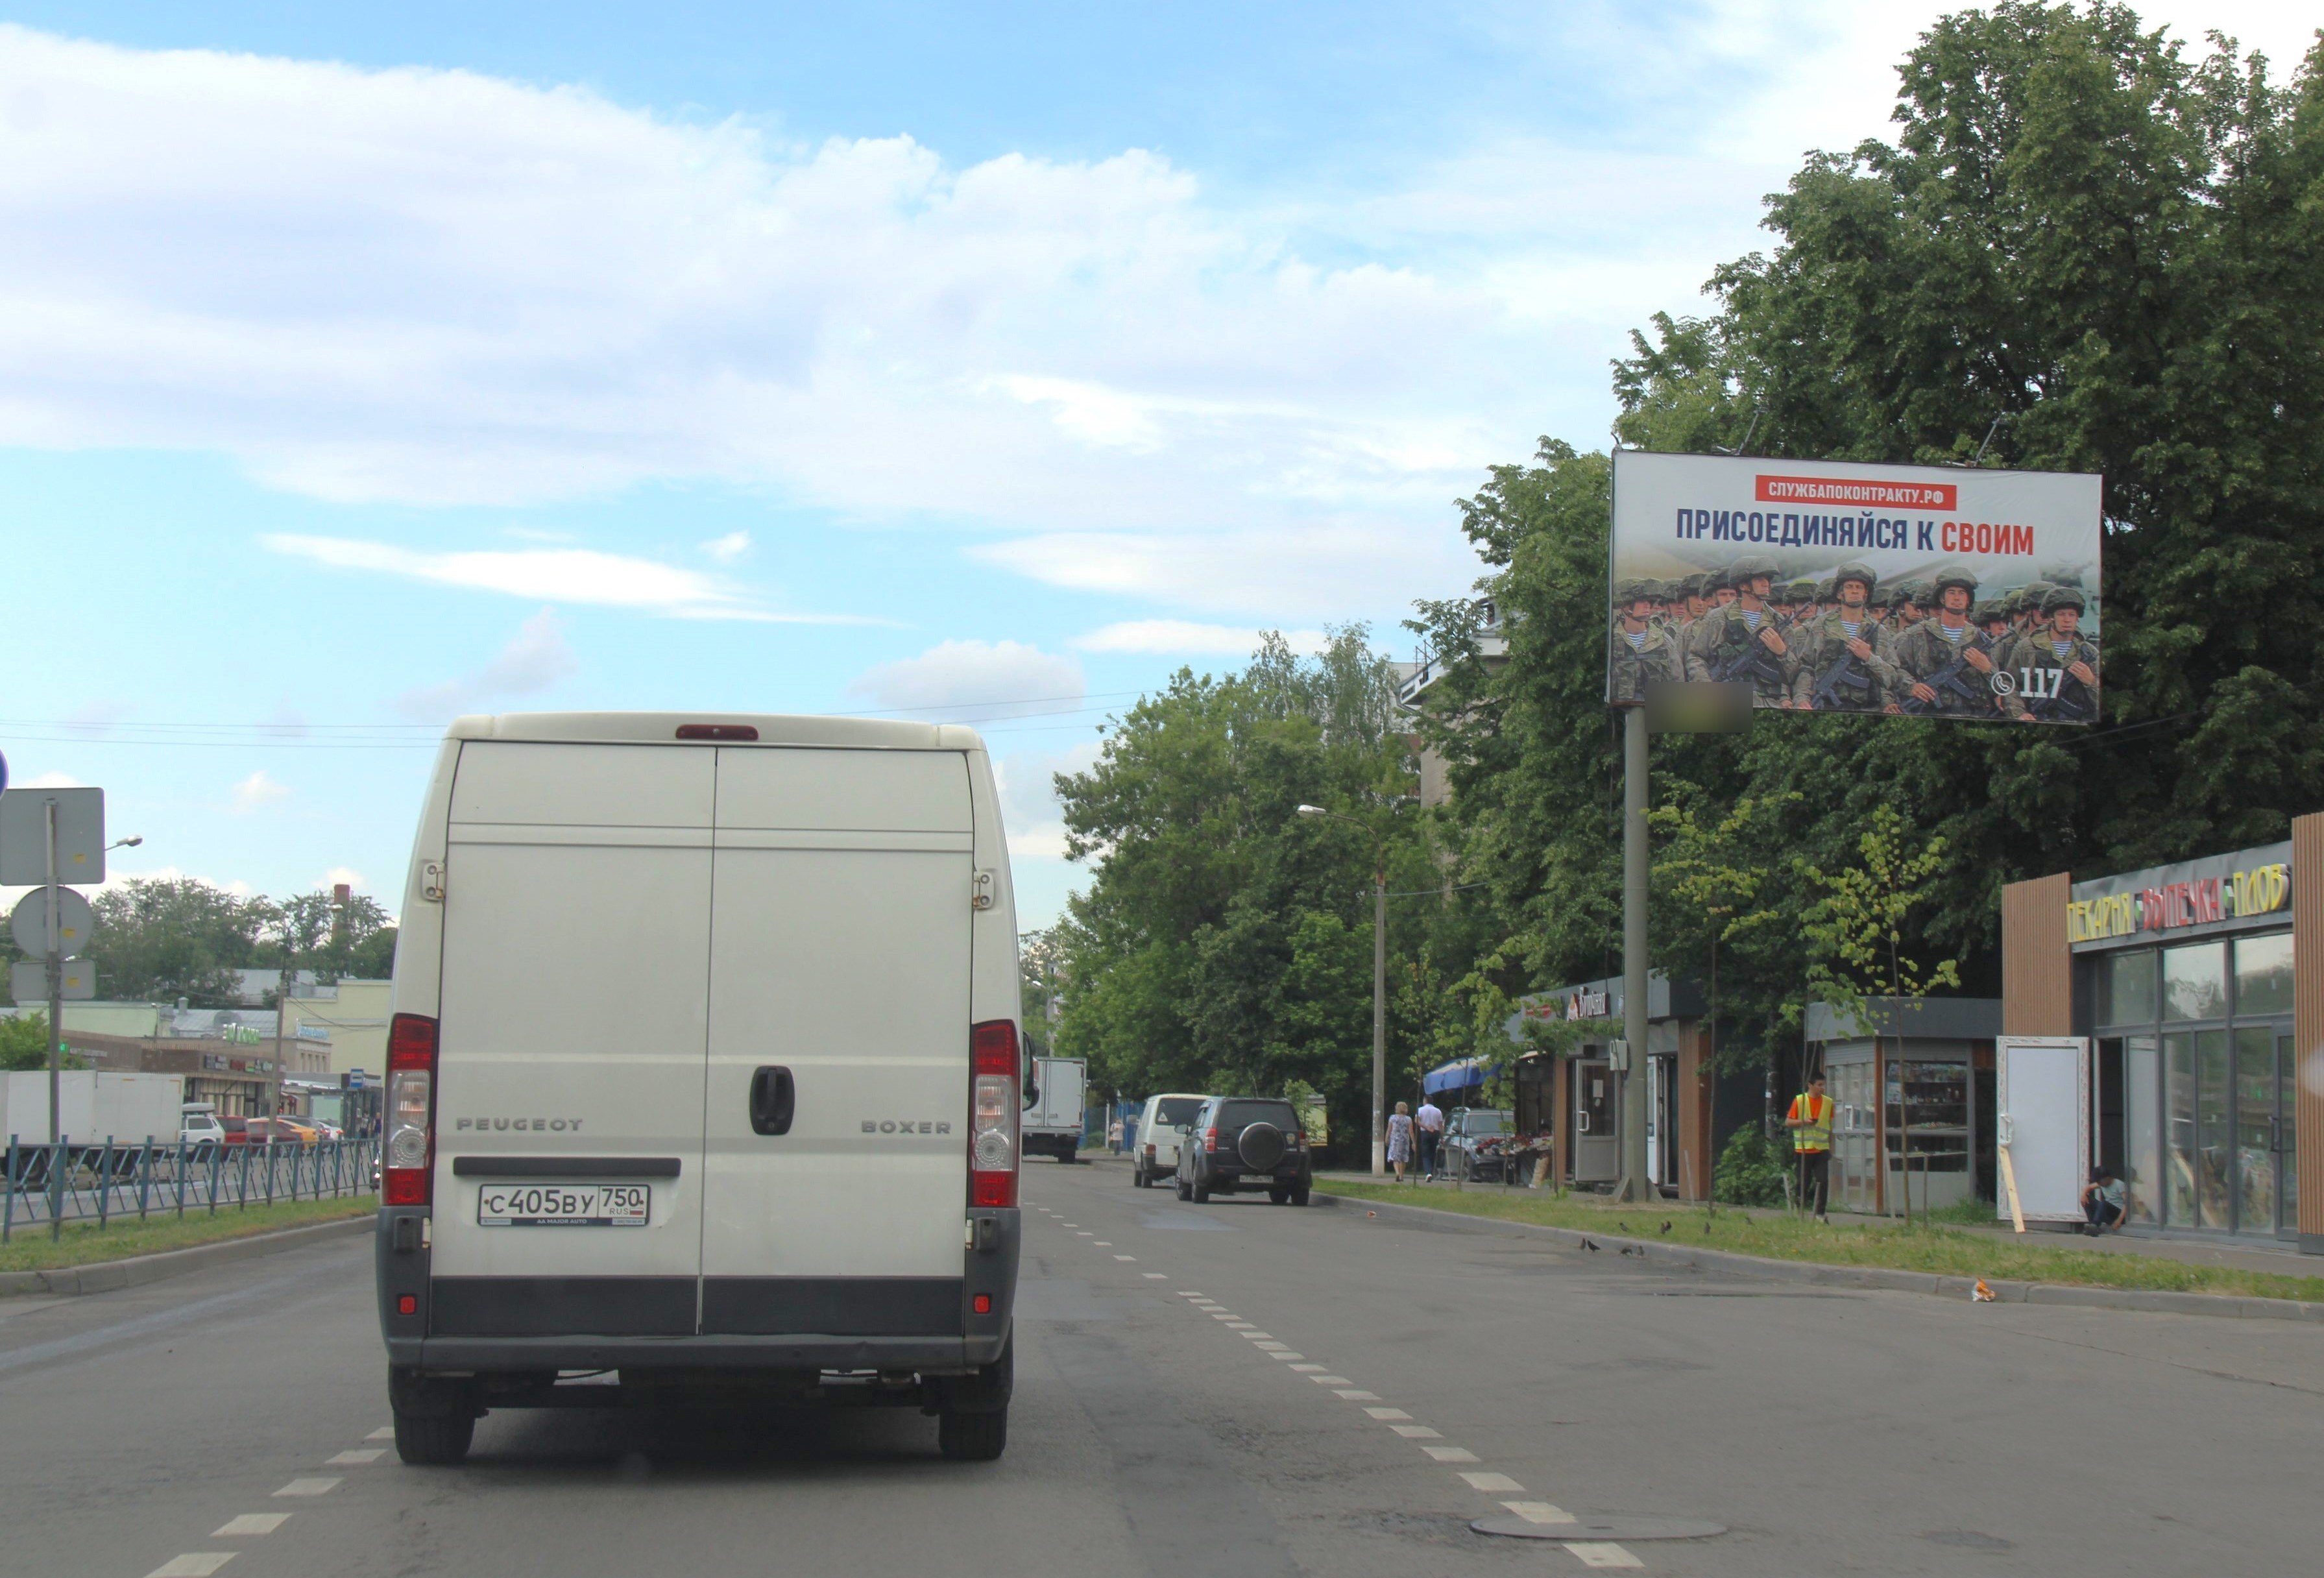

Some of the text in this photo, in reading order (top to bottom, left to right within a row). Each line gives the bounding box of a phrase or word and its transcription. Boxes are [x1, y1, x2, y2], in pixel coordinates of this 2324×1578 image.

[1768, 481, 1944, 505] СЛУЖБАПОКОНТРАКТУ.РФ
[1676, 508, 2034, 556] ПРИСОЕДИНЯЙСЯ К СВОИМ
[2020, 667, 2063, 699] 117
[2067, 863, 2288, 943] ПЕКАРНЯ ВЫПЕЧКА ПЛОВ
[456, 1117, 583, 1132] PEUGEOT
[861, 1119, 951, 1134] BOXER
[601, 1188, 641, 1207] 750
